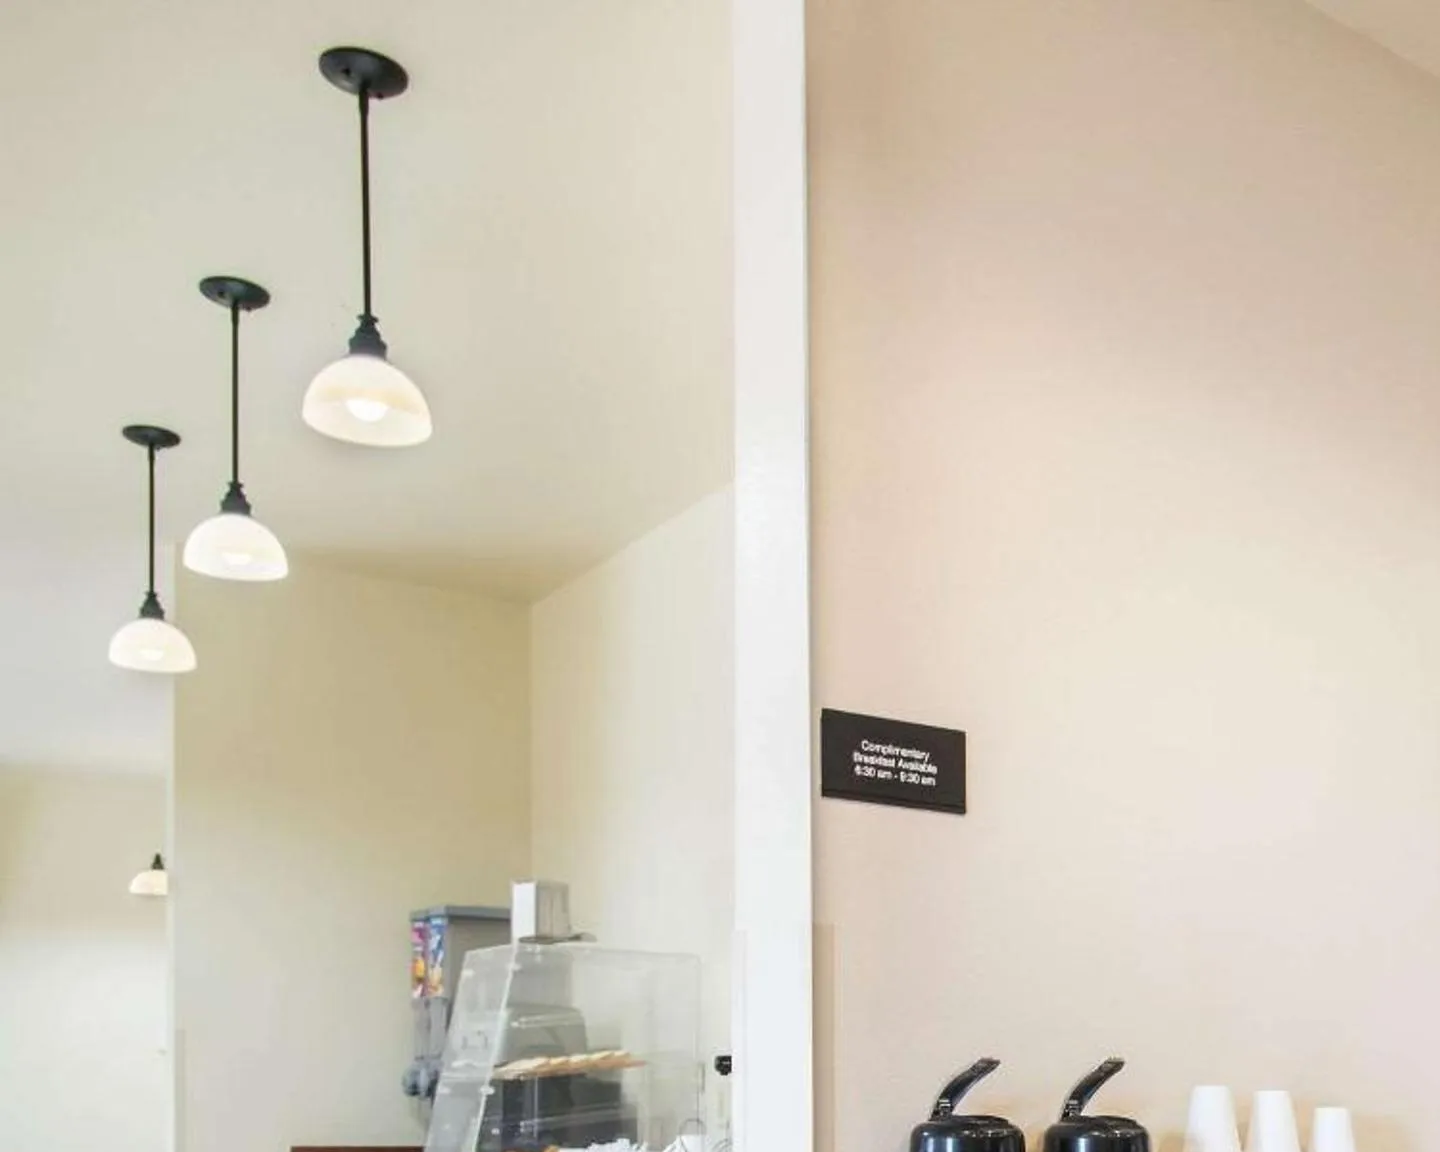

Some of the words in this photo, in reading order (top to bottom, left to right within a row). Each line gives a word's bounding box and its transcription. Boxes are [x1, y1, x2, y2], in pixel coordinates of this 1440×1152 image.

[853, 750, 895, 768] Breakfast
[898, 758, 938, 775] Available
[861, 740, 930, 762] Complimentary
